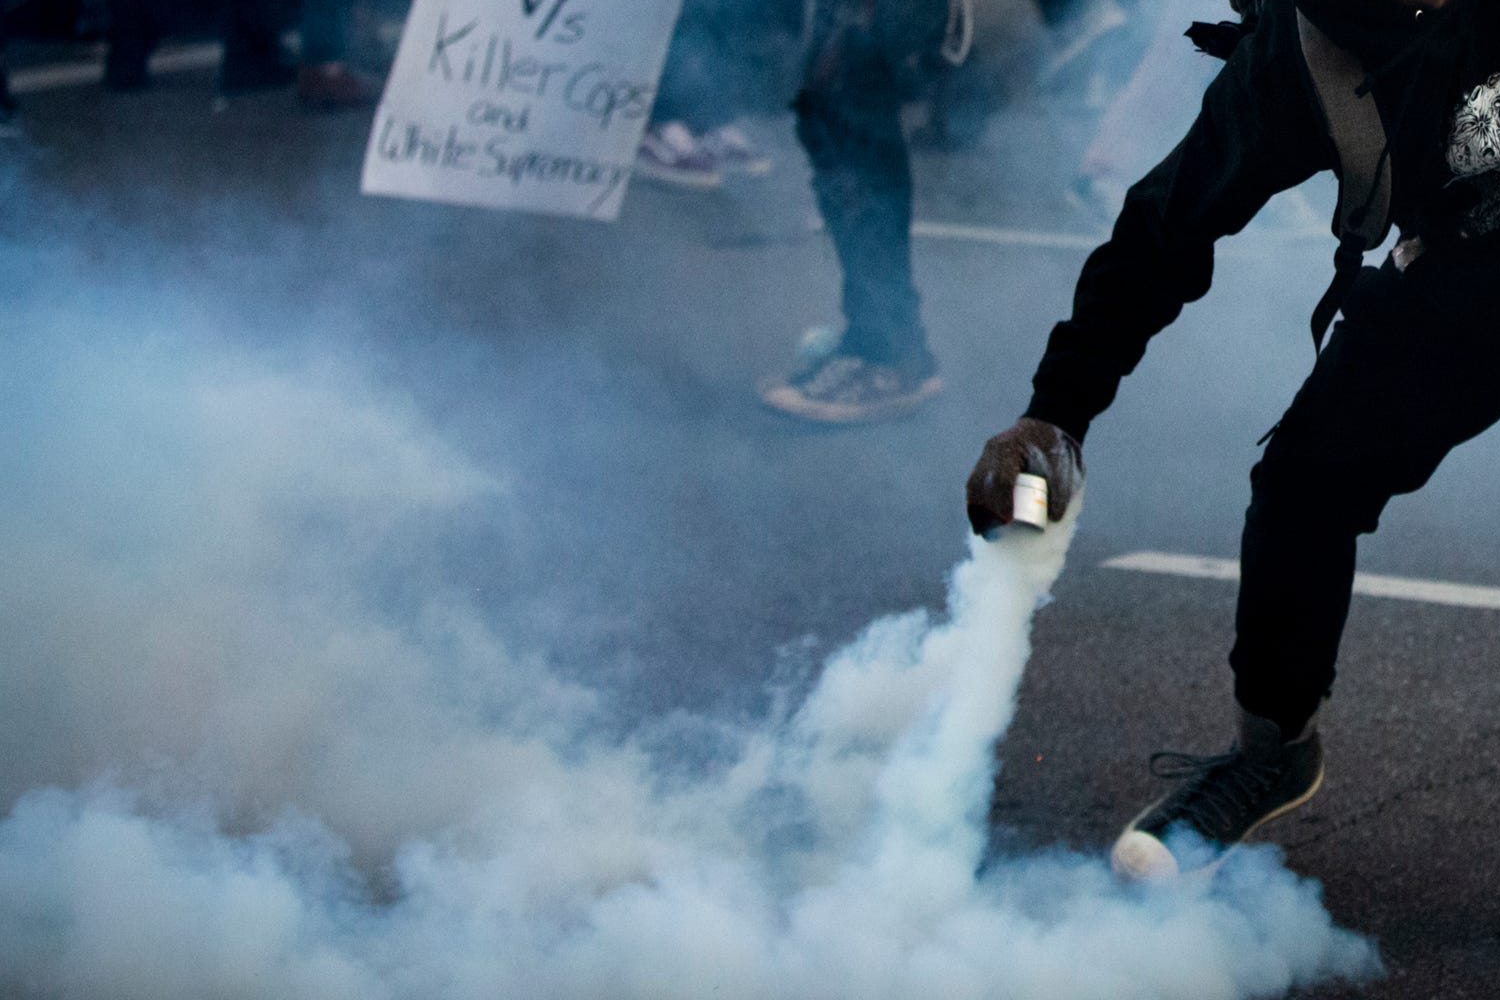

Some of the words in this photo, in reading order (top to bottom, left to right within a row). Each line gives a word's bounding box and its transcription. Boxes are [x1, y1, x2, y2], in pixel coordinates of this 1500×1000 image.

[428, 13, 568, 97] Killer
[563, 61, 650, 130] Cops
[466, 100, 532, 133] and
